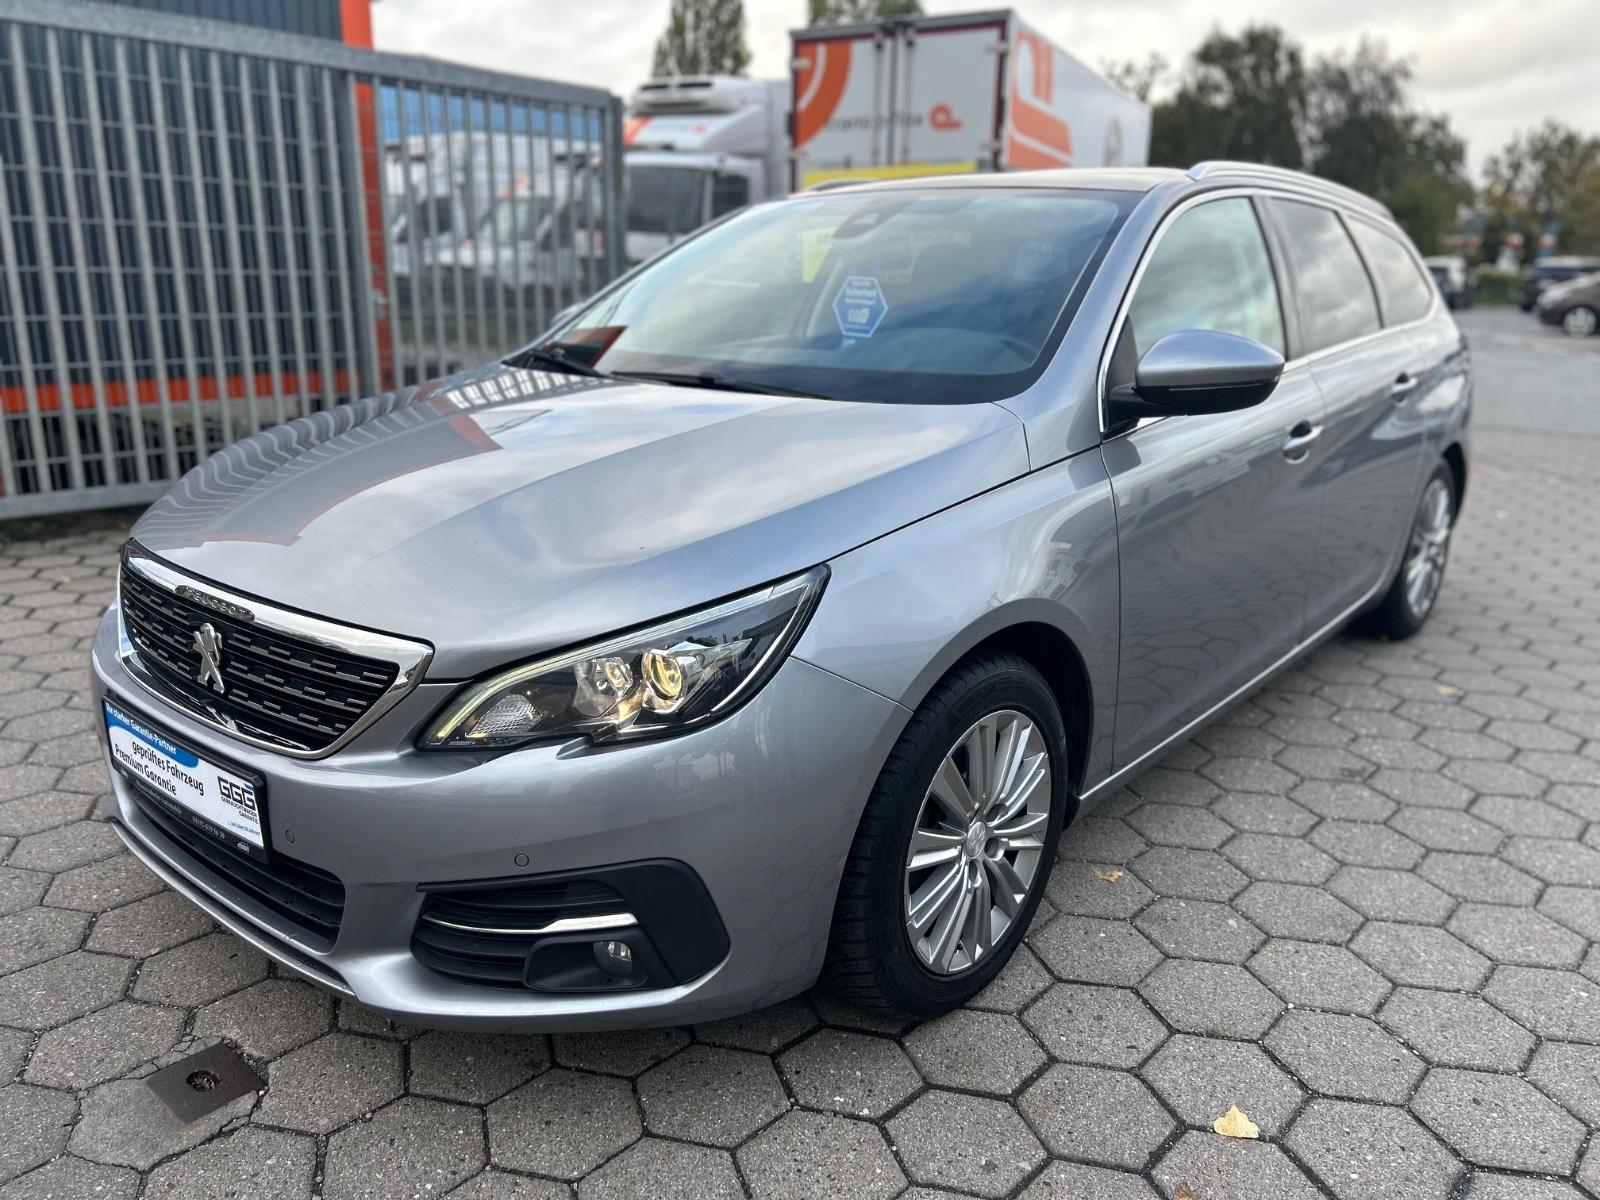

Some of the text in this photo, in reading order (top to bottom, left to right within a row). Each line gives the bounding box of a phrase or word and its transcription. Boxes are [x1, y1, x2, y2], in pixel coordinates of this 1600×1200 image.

[185, 587, 246, 617] PEUGEOT
[113, 709, 130, 726] starker
[131, 719, 177, 755] Garantie-Partner
[114, 743, 177, 795] Premium Garantie
[132, 741, 205, 796] geprüftes Fahrzeug
[217, 775, 256, 809] GGG
[238, 811, 259, 825] GARANTIE
